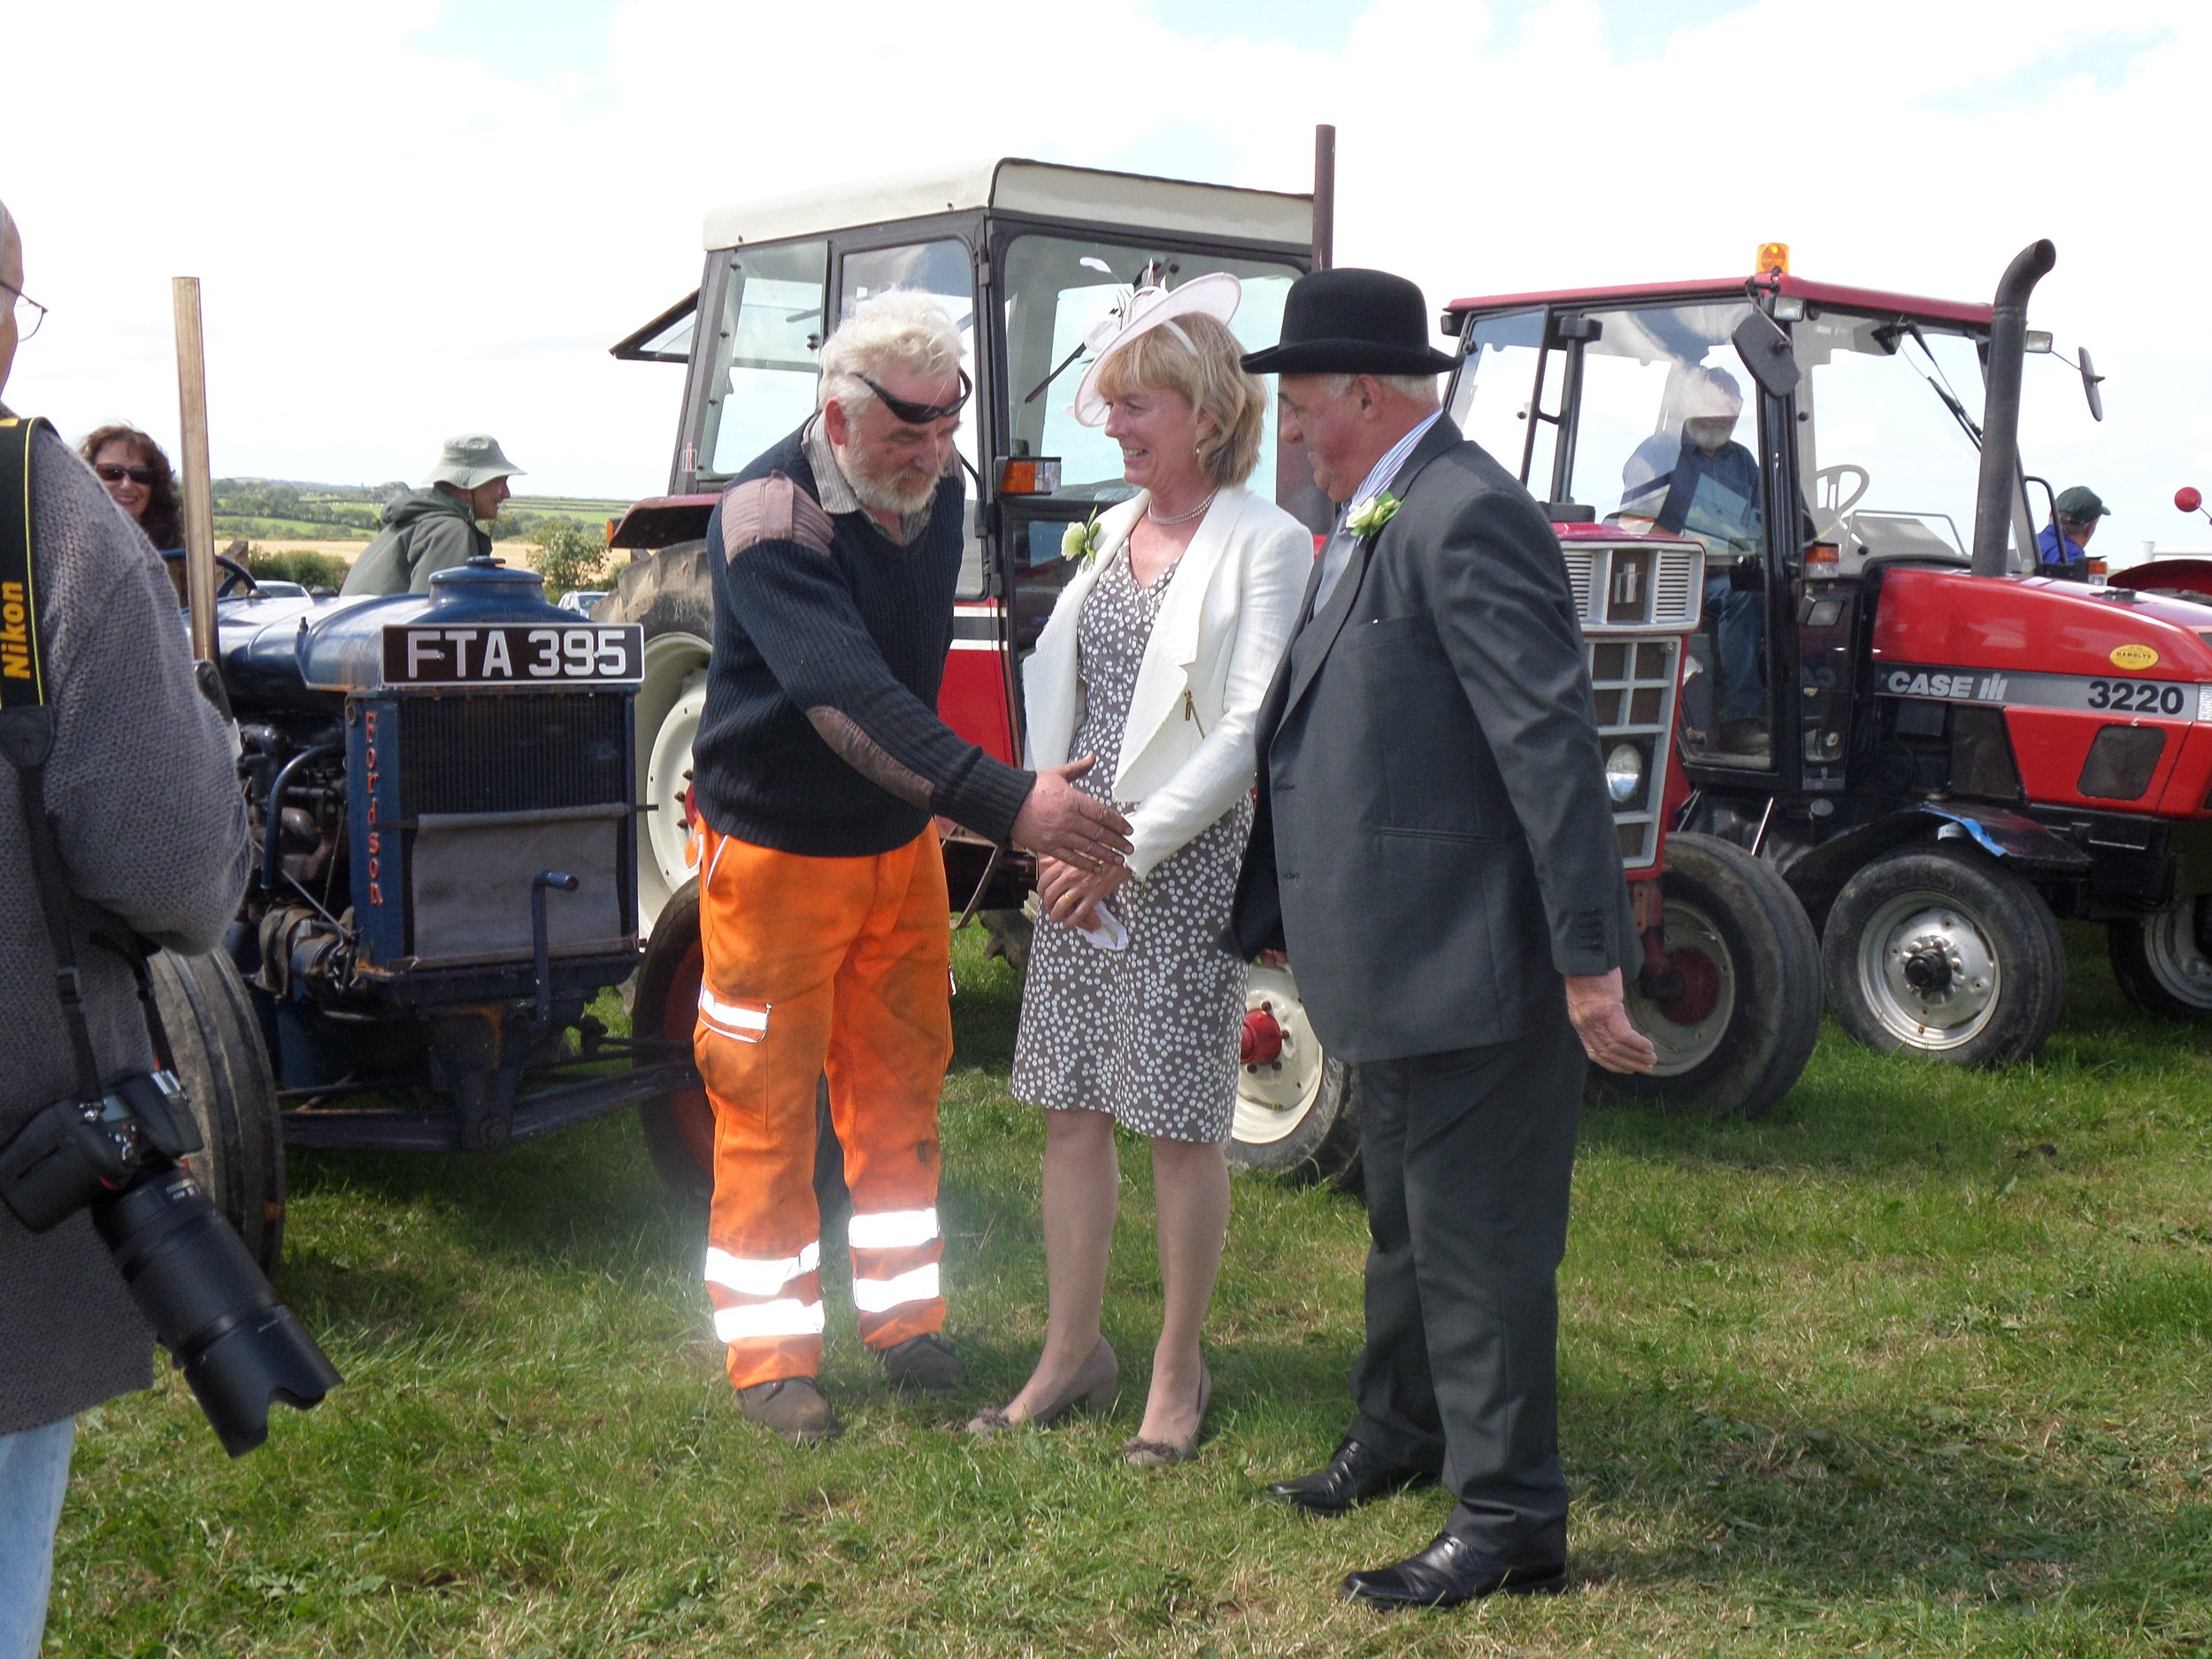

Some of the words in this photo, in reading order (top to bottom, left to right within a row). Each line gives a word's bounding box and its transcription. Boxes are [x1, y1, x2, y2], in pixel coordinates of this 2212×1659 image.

[0, 581, 31, 679] Nikon
[407, 629, 512, 679] FTA
[528, 629, 626, 677] 395
[1888, 670, 1974, 698] CASE
[2088, 680, 2185, 715] 3220
[365, 711, 383, 906] Fordson
